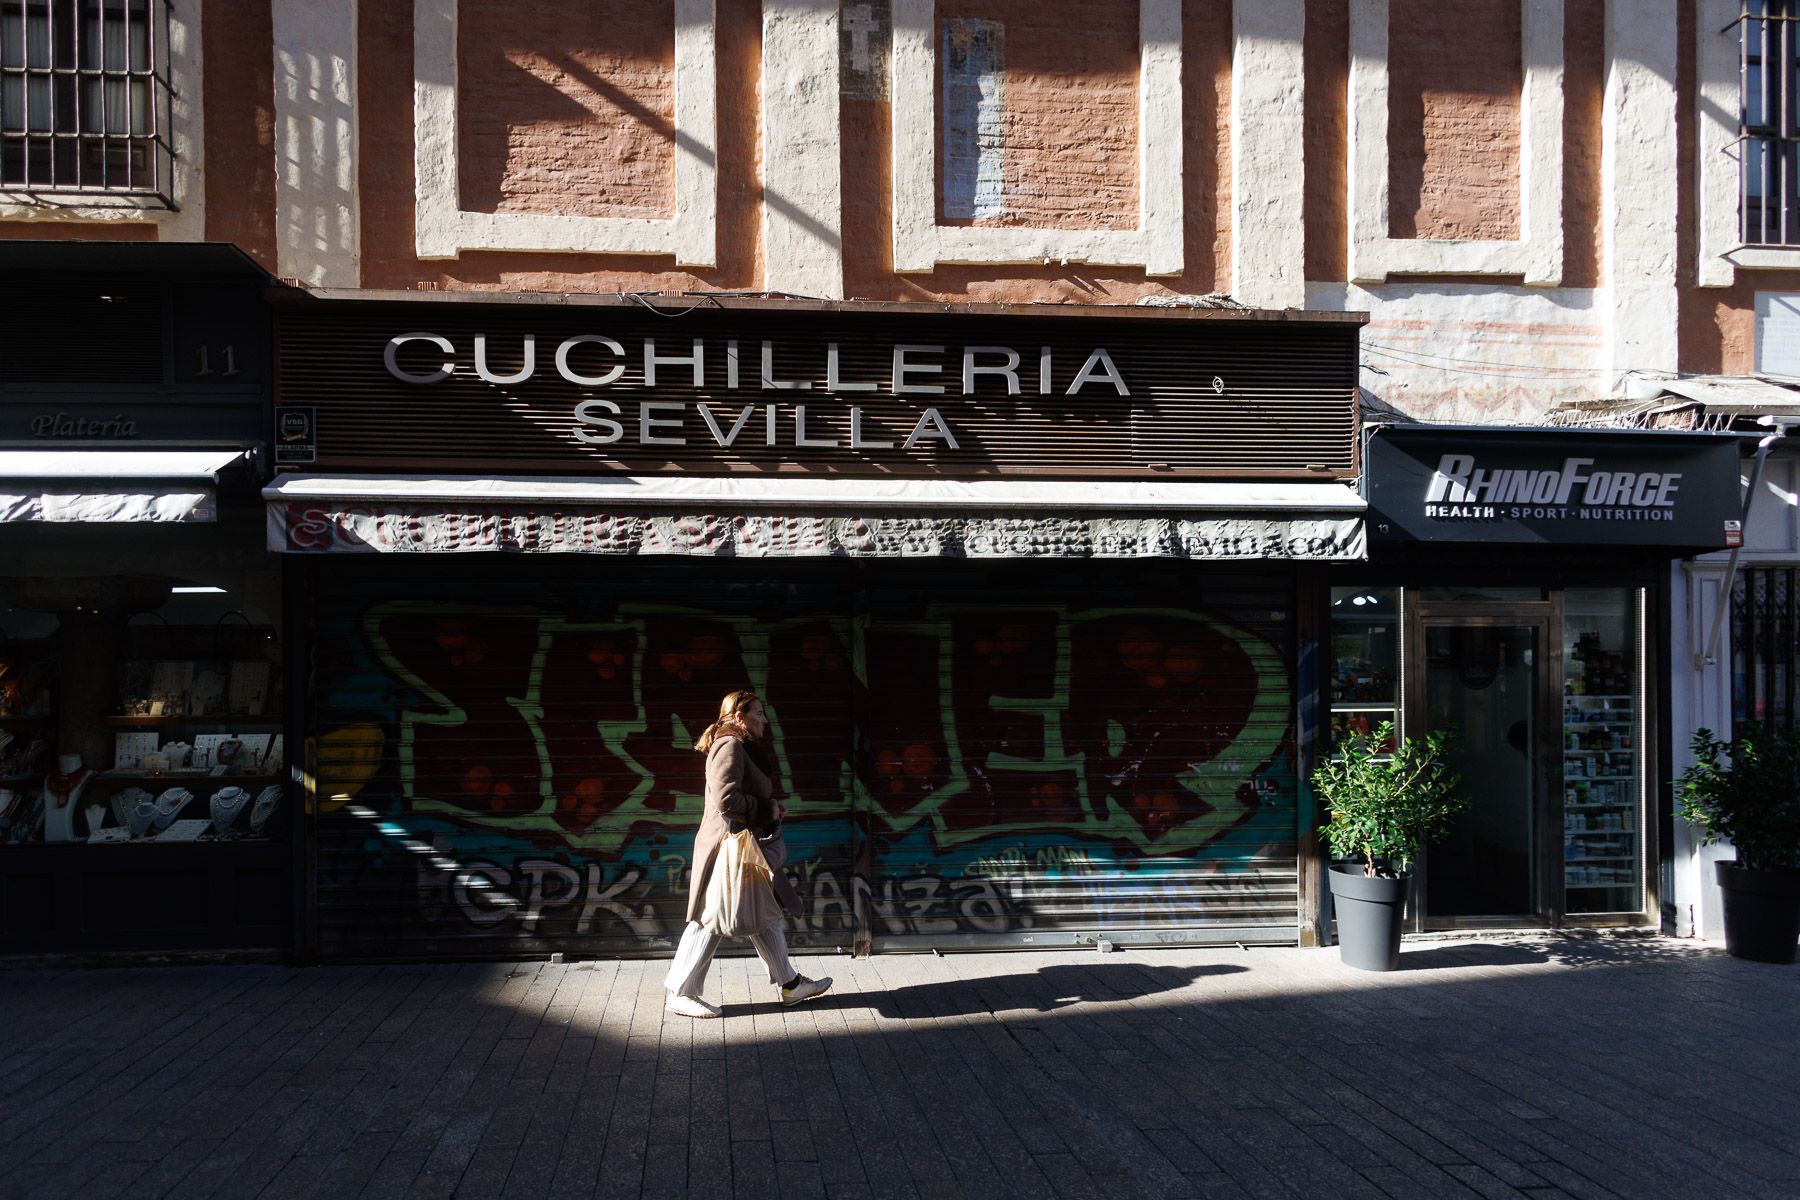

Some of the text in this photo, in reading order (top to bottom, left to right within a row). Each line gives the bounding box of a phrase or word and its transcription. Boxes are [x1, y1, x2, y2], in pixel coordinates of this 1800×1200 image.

[192, 344, 242, 377] 11
[383, 332, 1132, 397] CUCHILLERIA
[31, 412, 138, 438] Platería
[571, 399, 961, 450] SEVILLA
[1425, 504, 1674, 522] HEALTH SPORT NUTRITION
[1377, 524, 1390, 535] 13
